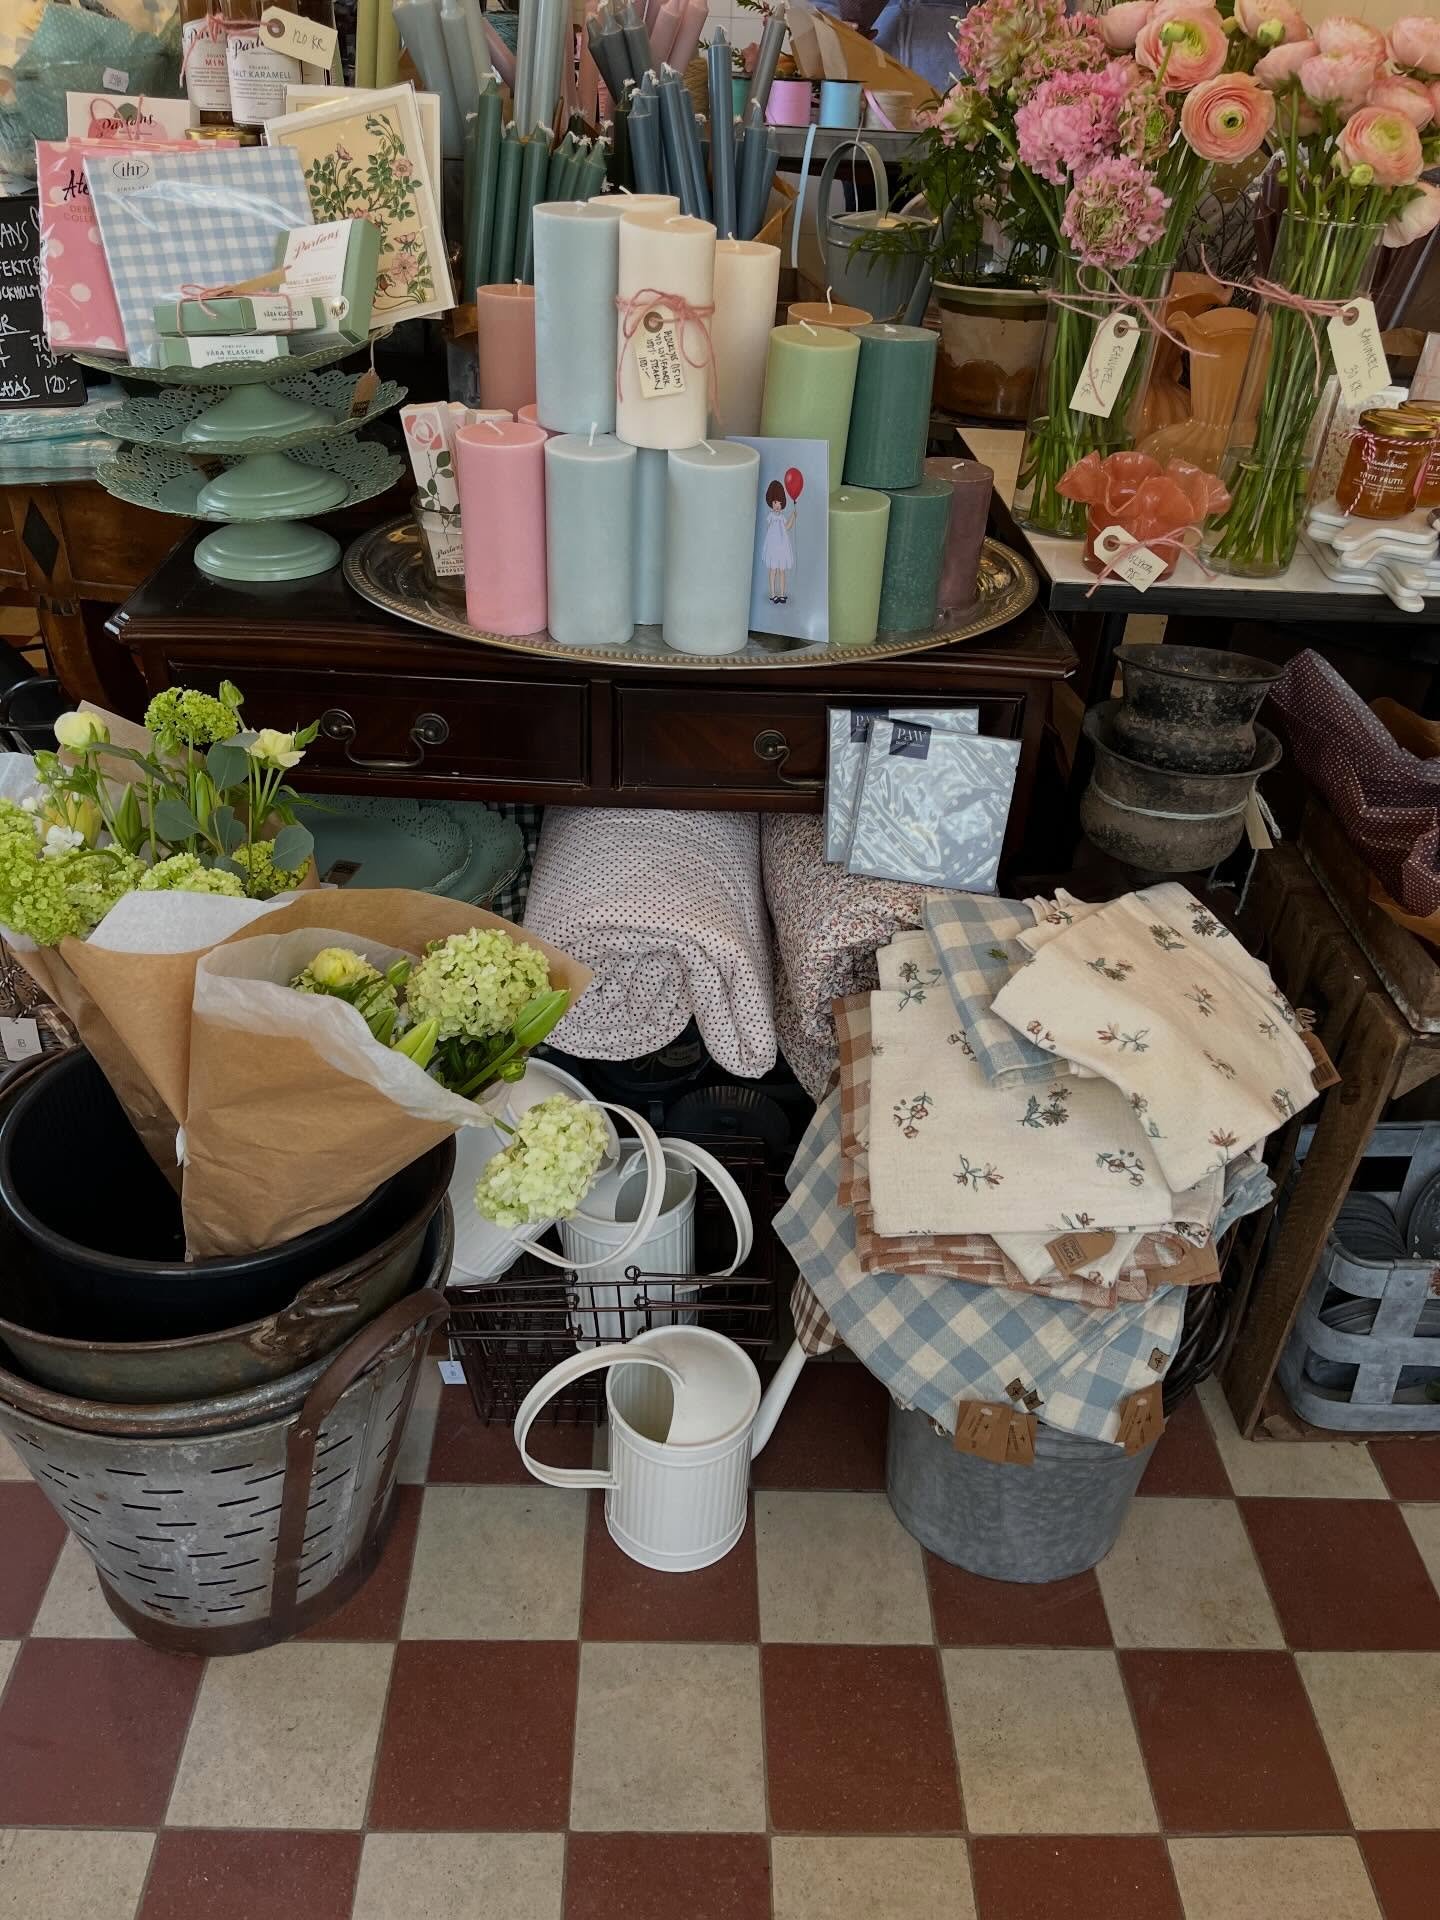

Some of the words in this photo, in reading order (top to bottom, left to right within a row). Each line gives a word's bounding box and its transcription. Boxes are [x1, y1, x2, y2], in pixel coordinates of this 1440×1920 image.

[248, 71, 292, 80] KARAMELL
[121, 162, 145, 177] ihr
[227, 348, 265, 356] KLASSIKER
[896, 727, 928, 742] PAW
